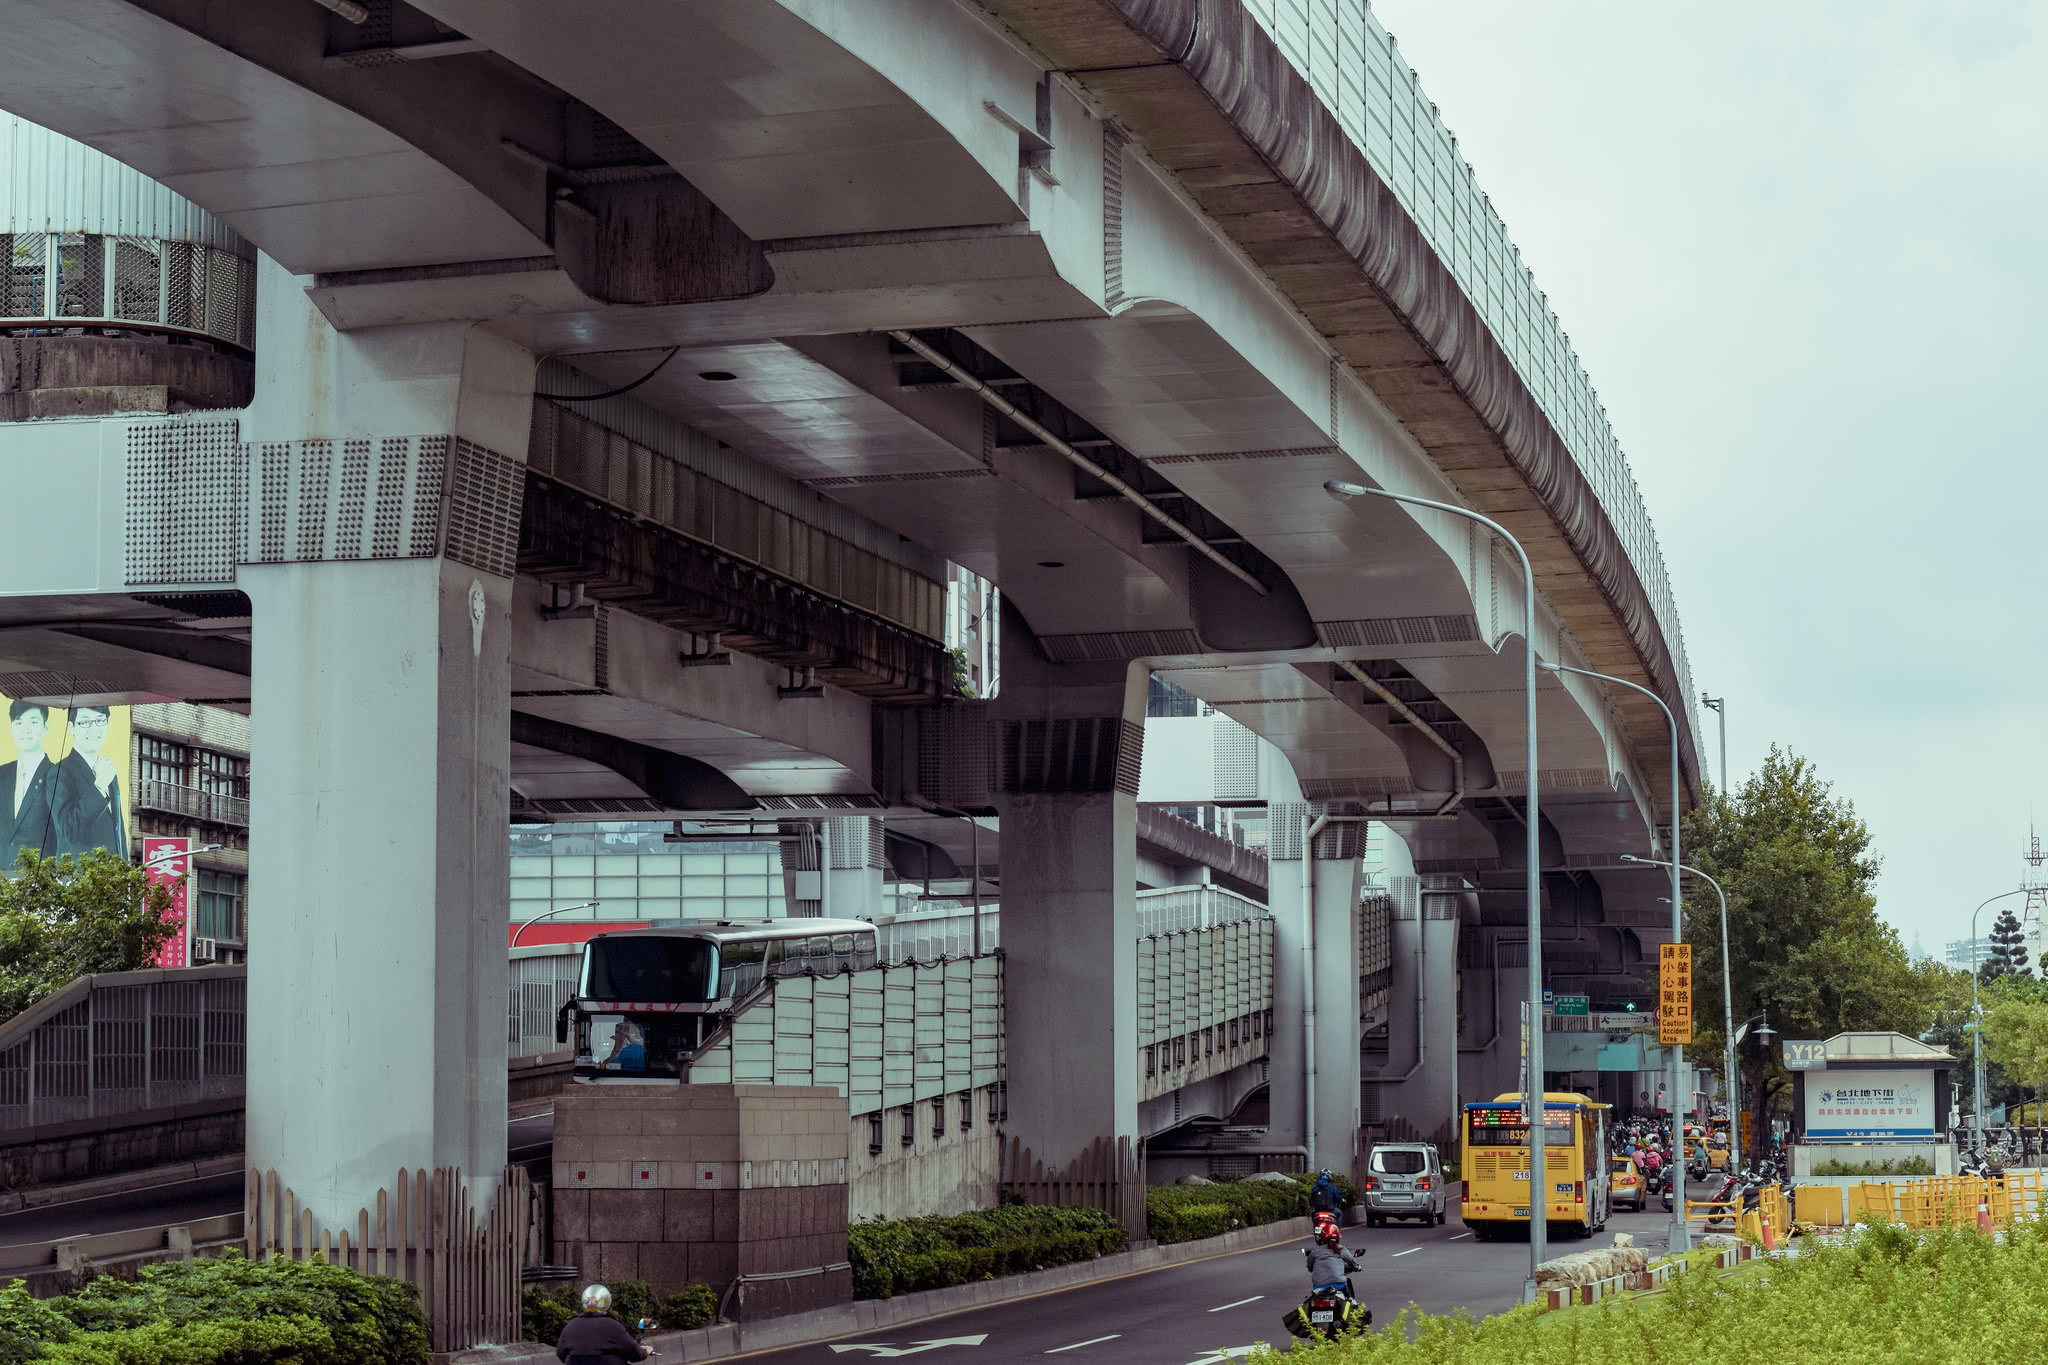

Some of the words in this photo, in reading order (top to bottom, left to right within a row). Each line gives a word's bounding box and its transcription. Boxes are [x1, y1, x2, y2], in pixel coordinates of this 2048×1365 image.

[1662, 946, 1675, 1018] 請小心駕駛
[1677, 946, 1689, 1016] 易肇事路口
[1791, 1044, 1825, 1060] Y12
[1836, 1089, 1894, 1097] 台北地下街
[1514, 1171, 1530, 1179] 218
